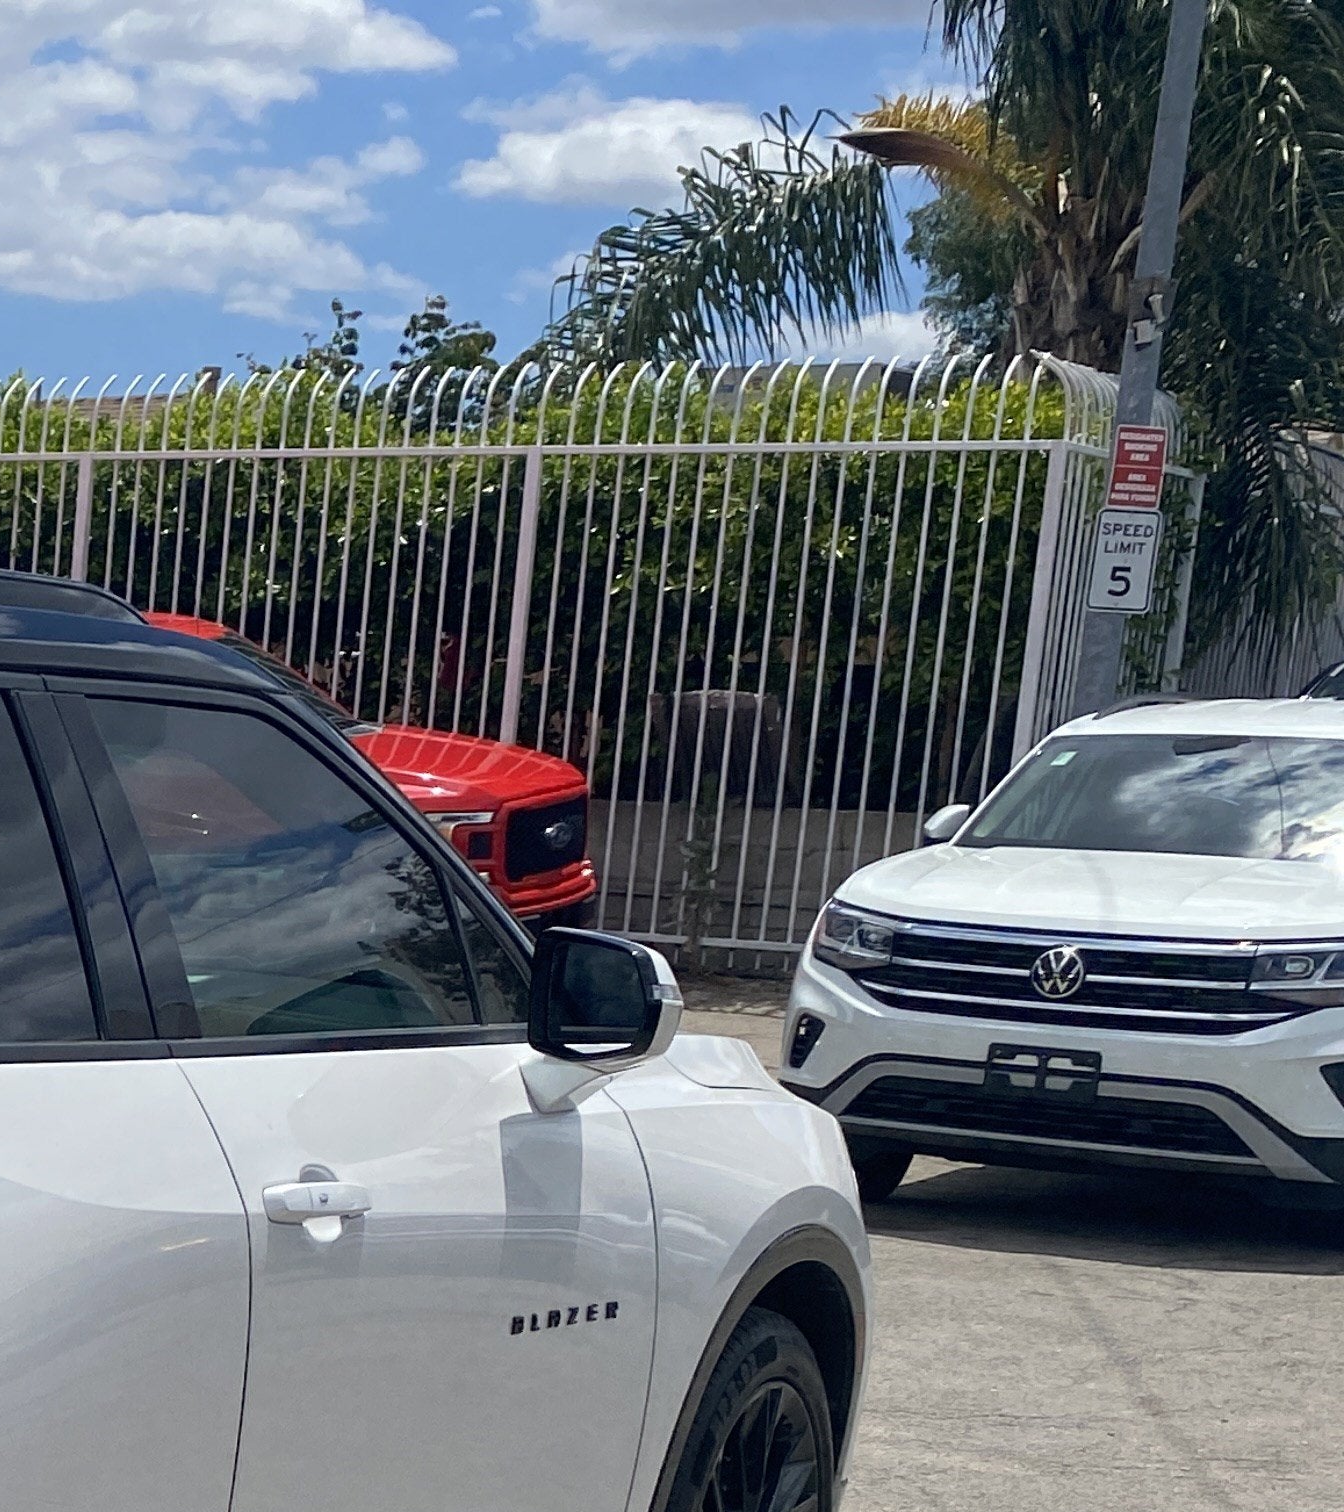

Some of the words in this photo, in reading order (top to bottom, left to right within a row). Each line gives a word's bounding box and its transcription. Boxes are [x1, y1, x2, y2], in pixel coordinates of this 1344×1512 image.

[1102, 522, 1154, 539] SPEED
[1104, 540, 1146, 556] LIMIT
[1108, 567, 1132, 597] 5
[511, 1301, 619, 1335] BLAZER
